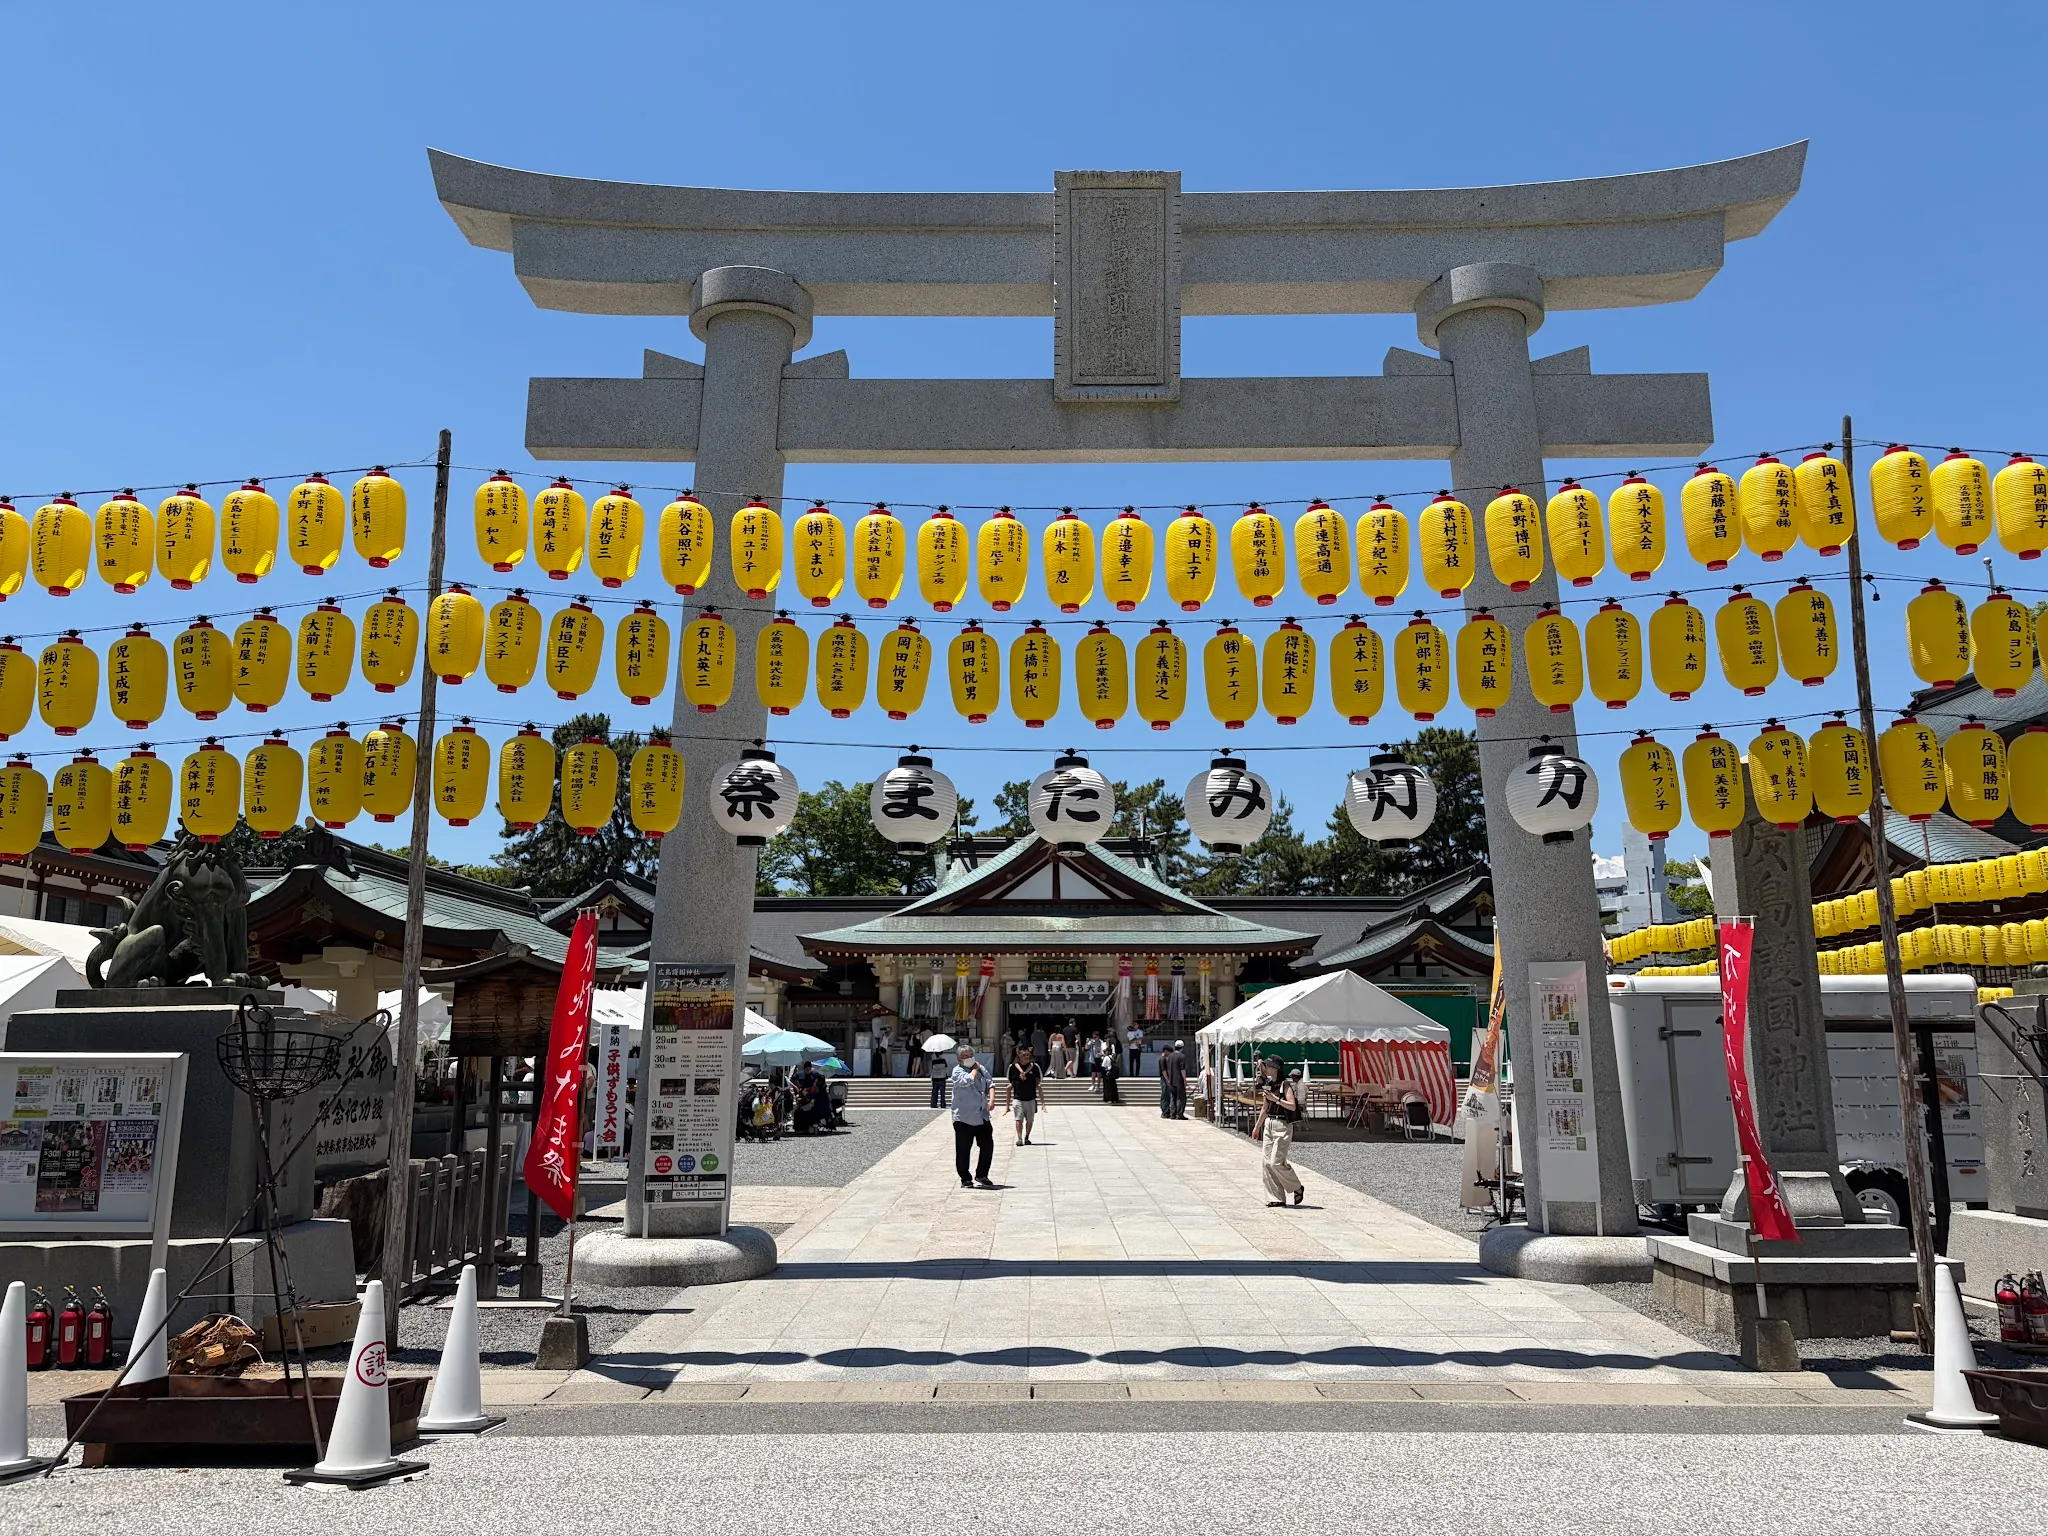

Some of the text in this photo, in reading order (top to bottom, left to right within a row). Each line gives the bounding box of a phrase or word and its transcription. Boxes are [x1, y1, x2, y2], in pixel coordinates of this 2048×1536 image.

[362, 482, 372, 540] 乙重明子
[1775, 470, 1792, 529] 広島駅弁当㈱
[1821, 464, 1845, 525] 岡本真理
[1907, 457, 1926, 517] 長石アツ子
[2031, 468, 2048, 530] 平岡節子
[166, 502, 182, 560] ㈱シンコー
[227, 497, 243, 555] 広島セレモニー㈱
[297, 489, 312, 548] 中野スミエ
[597, 502, 617, 559] 中光哲三
[676, 507, 693, 567] 板谷照子
[742, 515, 757, 574] 中村ユリ子
[1371, 515, 1389, 577] 河本紀六
[1511, 499, 1531, 560] 箕野博司
[1573, 494, 1592, 556] 株式会社イトー
[1636, 488, 1654, 551] 呉水交会
[807, 520, 823, 578] ㈱やまひ
[867, 521, 882, 581] 株式会社明宣社
[1054, 526, 1070, 585] 川本忍
[1186, 522, 1202, 581] 大田上子
[1252, 520, 1270, 578] 広島駅弁当㈱
[180, 634, 199, 694] 岡田ヒロ子
[199, 631, 212, 667] 呉市広小坪
[237, 627, 256, 686] 二井屋多一
[305, 618, 321, 678] 大前チエコ
[554, 615, 577, 674] 猪垣臣子
[626, 619, 643, 677] 岩本利信
[695, 626, 712, 688] 石丸英三
[892, 636, 912, 693] 岡田悦男
[1281, 635, 1300, 696] 得能末正
[1353, 632, 1370, 694] 古本一彰
[1414, 631, 1432, 693] 阿部和実
[1480, 627, 1497, 690] 大西正敏
[2005, 606, 2023, 670] 松島ヨシコ
[42, 650, 58, 711] ㈱ニチエイ
[115, 645, 131, 705] 児玉成男
[961, 640, 979, 701] 岡田悦男
[1023, 639, 1039, 699] 土橋和代
[1094, 639, 1111, 701] デルタ工業株式会社
[1154, 639, 1171, 701] 平義清之
[1223, 639, 1240, 702] ㈱ニチエイ
[187, 758, 203, 819] 久保井昭人
[251, 753, 268, 814] 広島セレモニー㈱
[363, 737, 379, 798] 根石健一
[1526, 756, 1587, 810] 万
[1646, 750, 1670, 811] 川本フジ子
[1780, 738, 1799, 801] 田中美佐子
[1915, 731, 1939, 792] 石本友三郎
[117, 765, 135, 826] 伊藤達雄
[720, 764, 781, 821] 祭
[881, 769, 940, 821] ま
[1042, 770, 1101, 822] た
[1208, 769, 1267, 820] み
[1365, 769, 1426, 823] 灯
[657, 967, 700, 976] 広島護国神社
[659, 977, 729, 990] 万灯みたま祭
[1034, 983, 1106, 993] 子供ずもう大会
[604, 1049, 621, 1144] 子供ずもう大会
